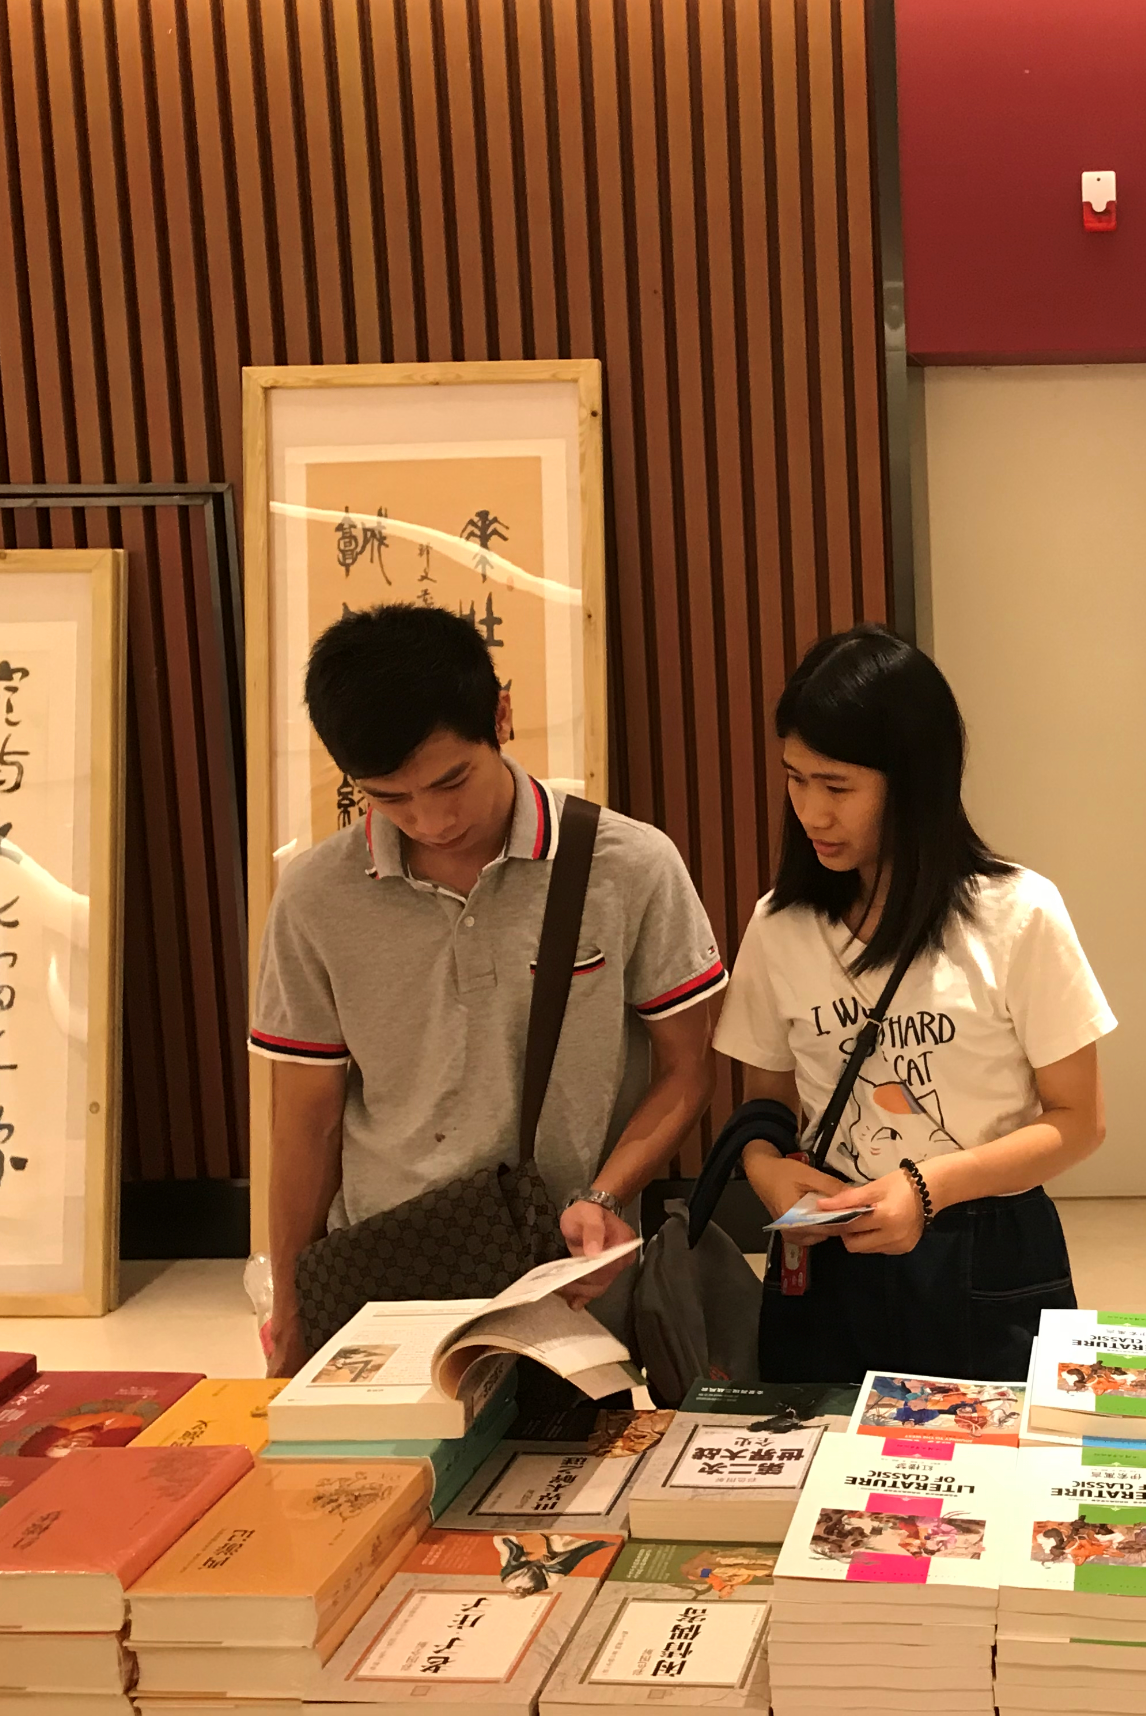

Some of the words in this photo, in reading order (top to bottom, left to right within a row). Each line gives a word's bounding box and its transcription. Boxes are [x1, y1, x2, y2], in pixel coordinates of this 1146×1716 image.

[811, 1005, 831, 1037] I
[888, 1011, 956, 1049] HARD
[893, 1050, 934, 1086] CAT
[1089, 1335, 1143, 1344] CLASSIC
[734, 1436, 776, 1447] 全史
[691, 1447, 805, 1462] 世界大战
[697, 1462, 786, 1476] 第二次
[1090, 1471, 1142, 1480] 伊索寓言
[867, 1470, 930, 1483] CLASSIC
[934, 1475, 956, 1484] OF
[844, 1475, 976, 1495] LITERATURE
[1071, 1481, 1133, 1490] CLASSIC
[651, 1606, 708, 1677] 闲情偶寄
